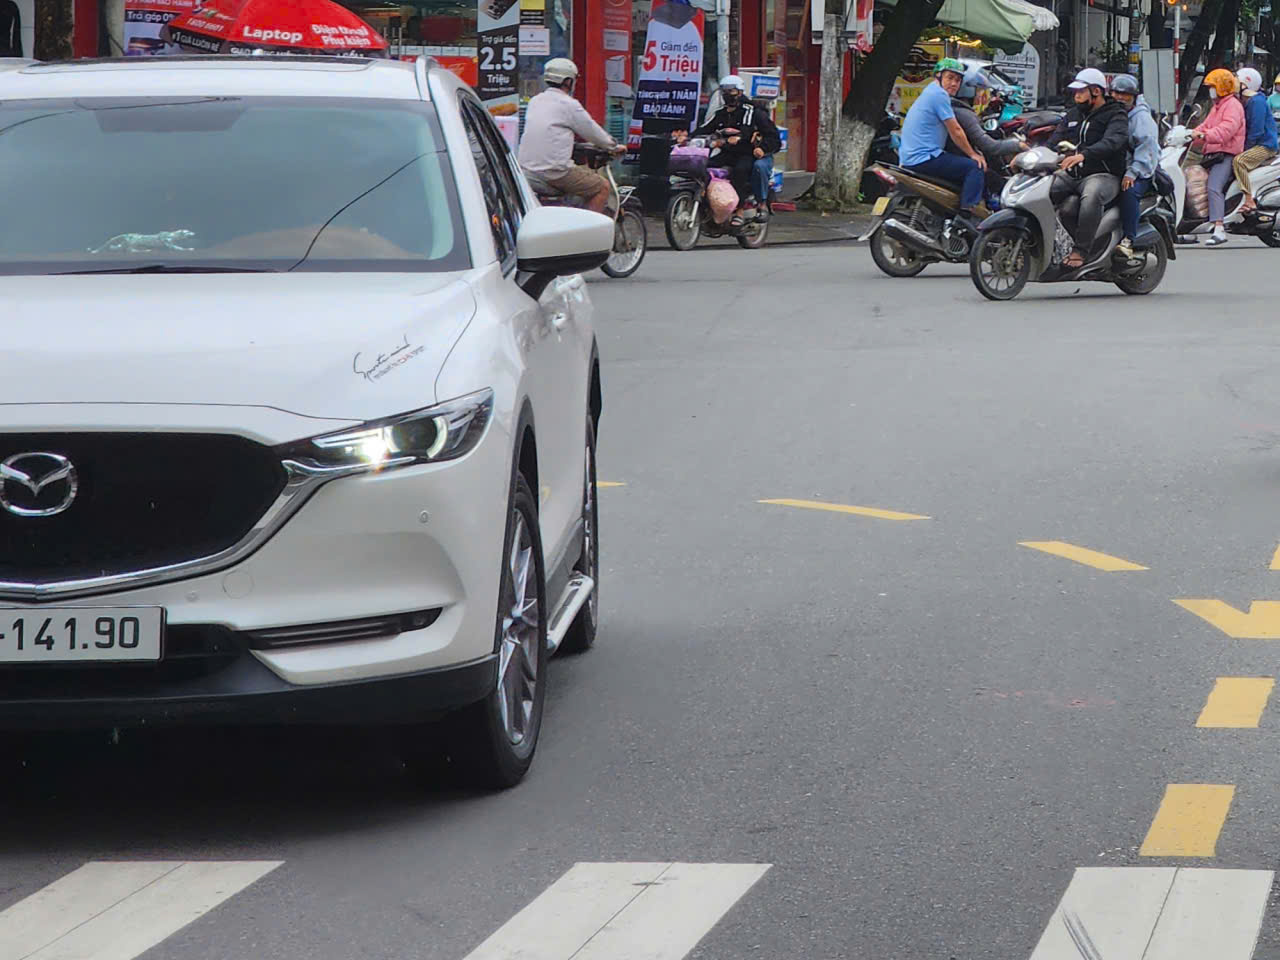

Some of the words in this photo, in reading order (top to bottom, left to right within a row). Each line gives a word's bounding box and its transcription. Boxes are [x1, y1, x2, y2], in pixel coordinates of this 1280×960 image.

[146, 11, 162, 23] góp
[243, 25, 304, 43] Laptop
[480, 46, 517, 71] 2.5
[642, 40, 657, 72] 5
[659, 54, 700, 78] Triệu
[486, 73, 510, 86] Triệu
